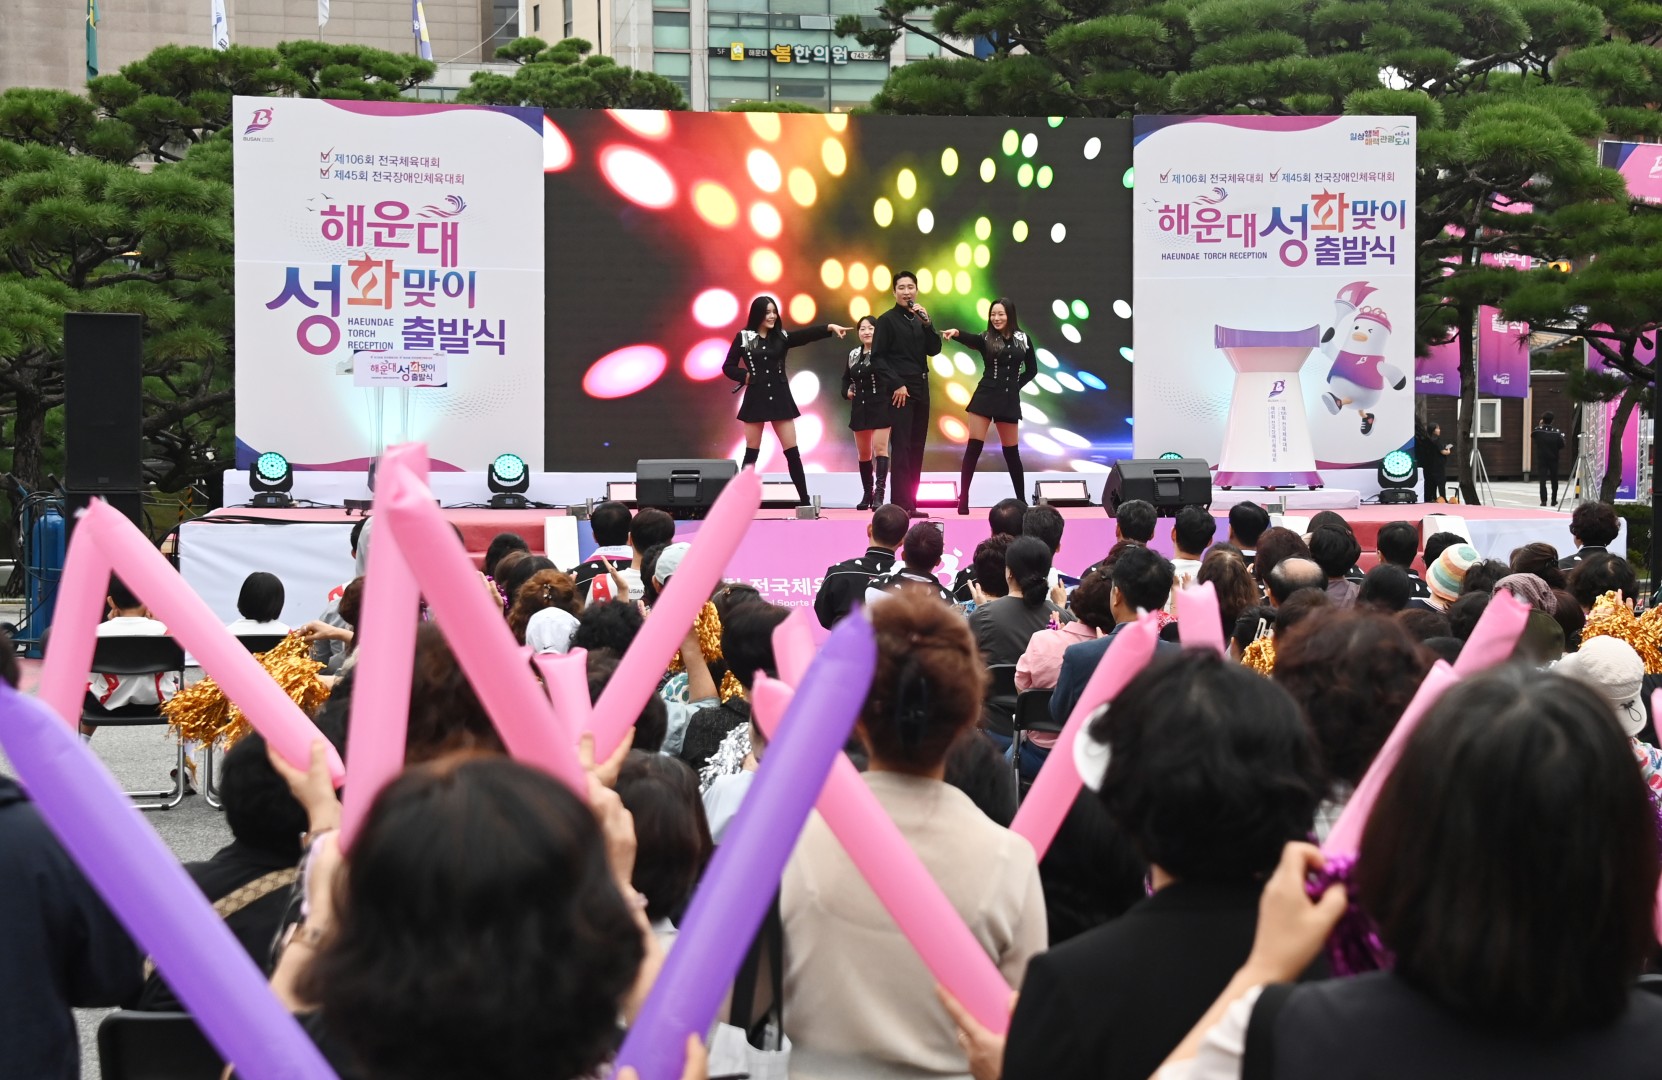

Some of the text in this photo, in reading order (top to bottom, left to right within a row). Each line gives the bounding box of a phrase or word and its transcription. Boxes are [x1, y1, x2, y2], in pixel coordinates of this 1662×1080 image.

[748, 44, 849, 65] 해운대 봄한의원
[334, 153, 441, 169] 제106회 전국체육대회
[333, 169, 465, 185] 제45회 전국장애인체육대회
[1172, 171, 1395, 184] 제106회 전국체육대회 제45회 전국장애인체육대회
[1158, 203, 1257, 249] 해운대
[320, 200, 460, 268] 해운대
[1161, 251, 1268, 261] HAEUNDAE TORCH RECEPTION
[1314, 235, 1396, 266] 출발식
[347, 317, 394, 327] HAEUNDAE
[347, 329, 376, 338] TORCH
[401, 316, 506, 356] 출발식
[347, 340, 394, 350] RECEPTION
[370, 362, 397, 375] 해운대
[411, 373, 433, 382] 출발식
[777, 599, 810, 607] Sports
